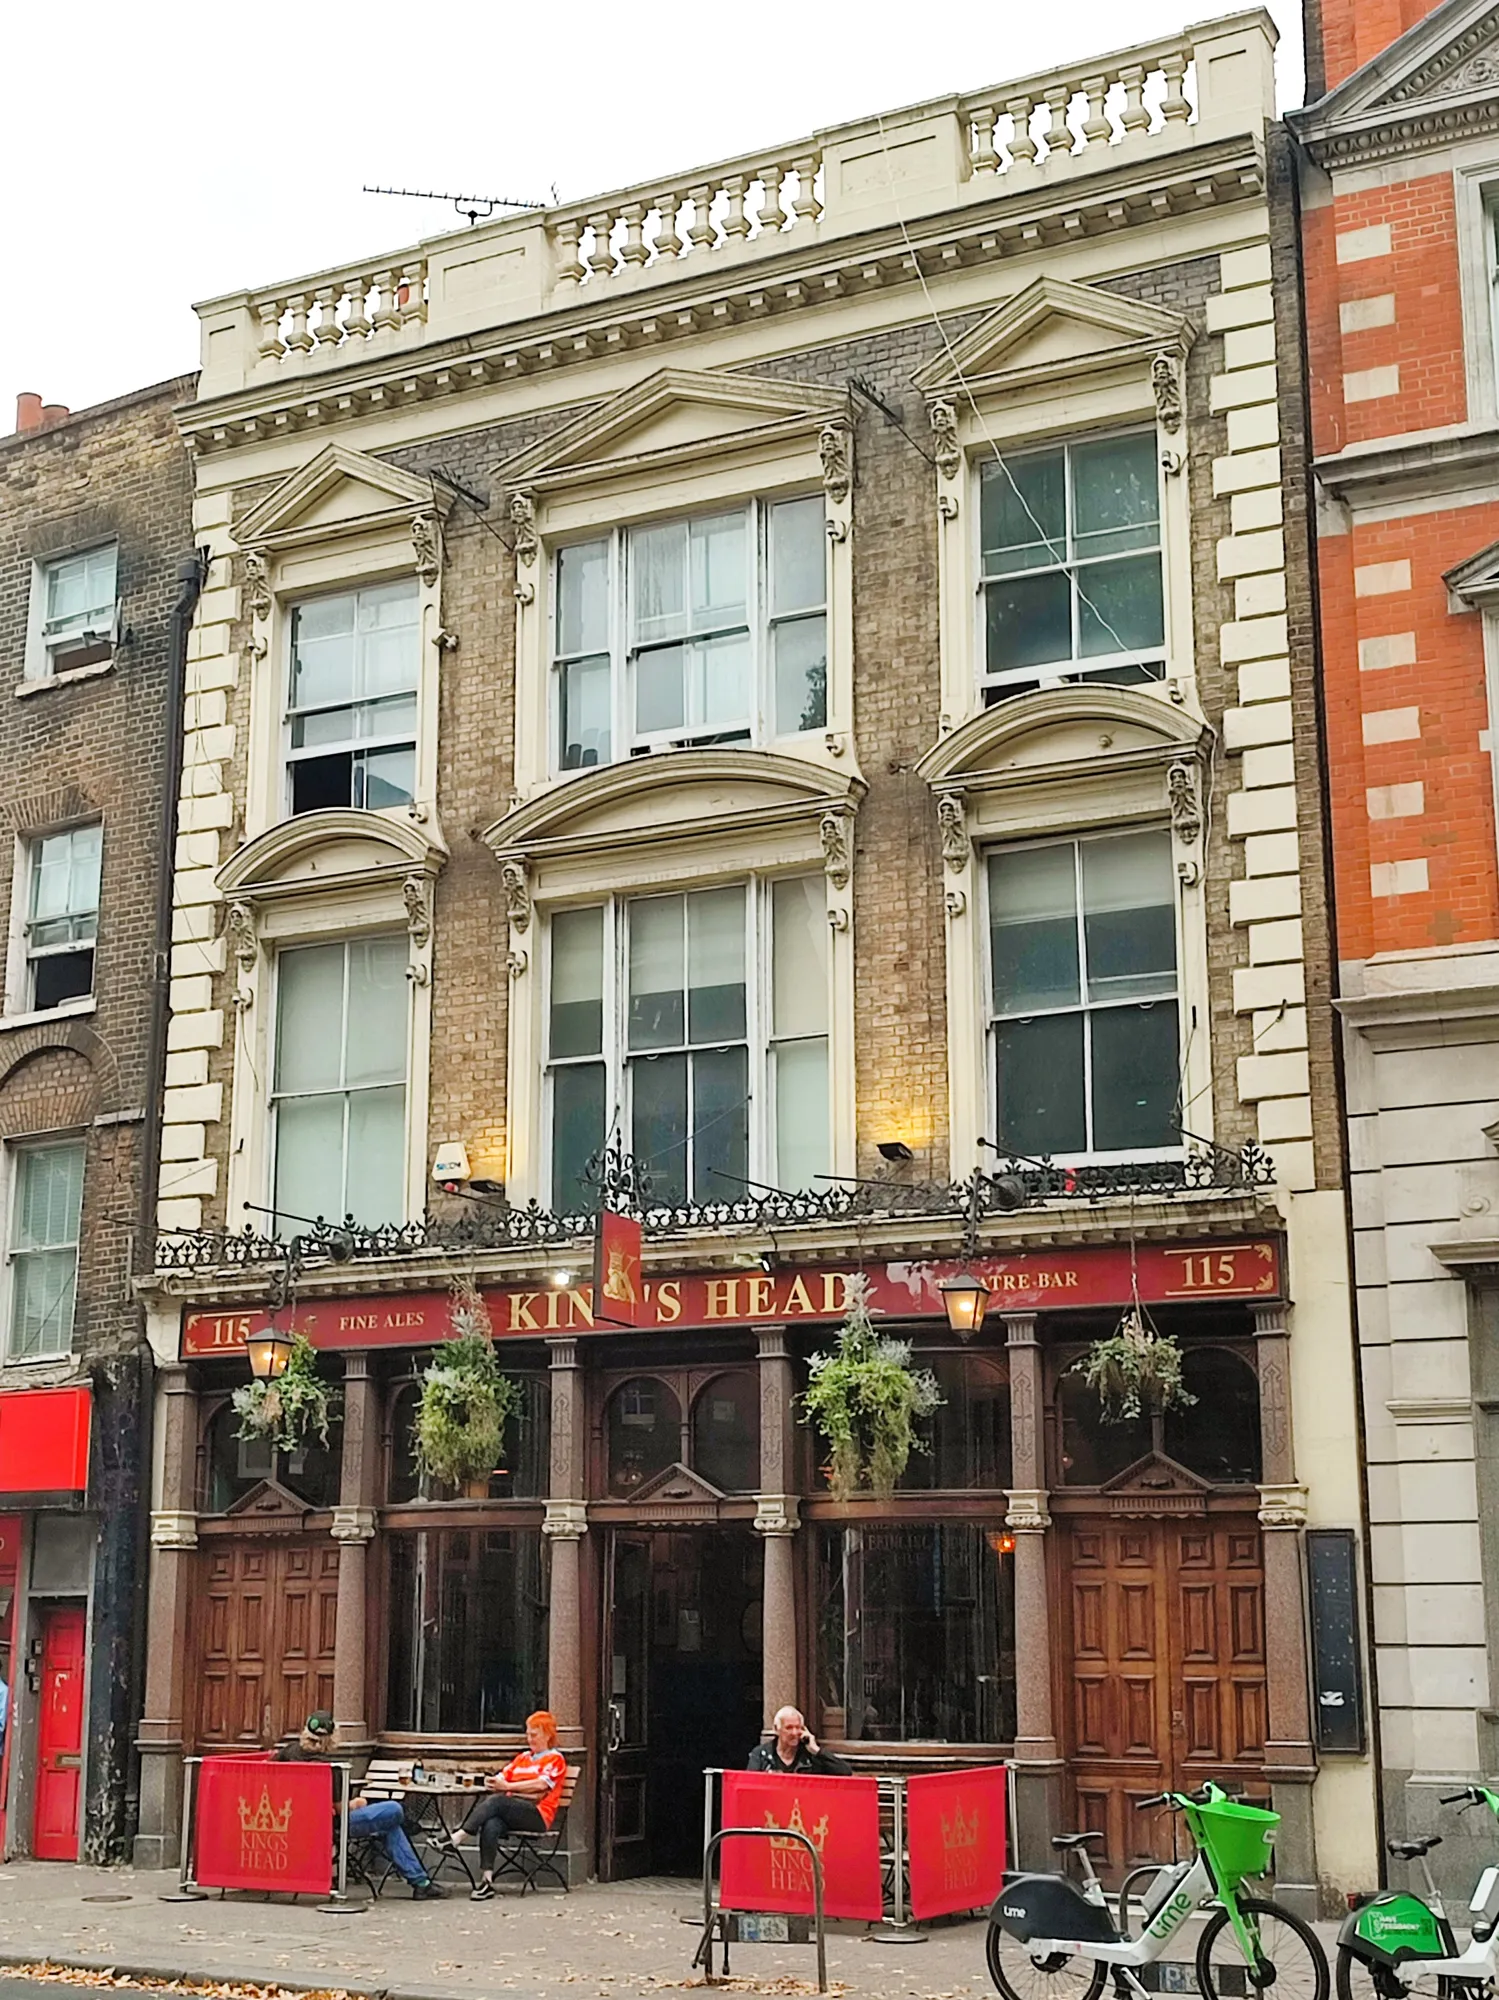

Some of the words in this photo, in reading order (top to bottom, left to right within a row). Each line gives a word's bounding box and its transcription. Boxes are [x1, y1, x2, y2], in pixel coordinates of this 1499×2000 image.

[935, 1274, 1031, 1294] TATRE
[1038, 1271, 1079, 1288] BAR
[1182, 1254, 1235, 1287] 115
[506, 1281, 682, 1331] KIN'S
[703, 1272, 857, 1319] HEAD
[212, 1317, 251, 1346] 115
[339, 1315, 379, 1331] FINE
[383, 1312, 425, 1328] ALES
[240, 1850, 288, 1871] HEAD
[944, 1866, 978, 1890] HEAD
[1149, 1893, 1192, 1939] Lime
